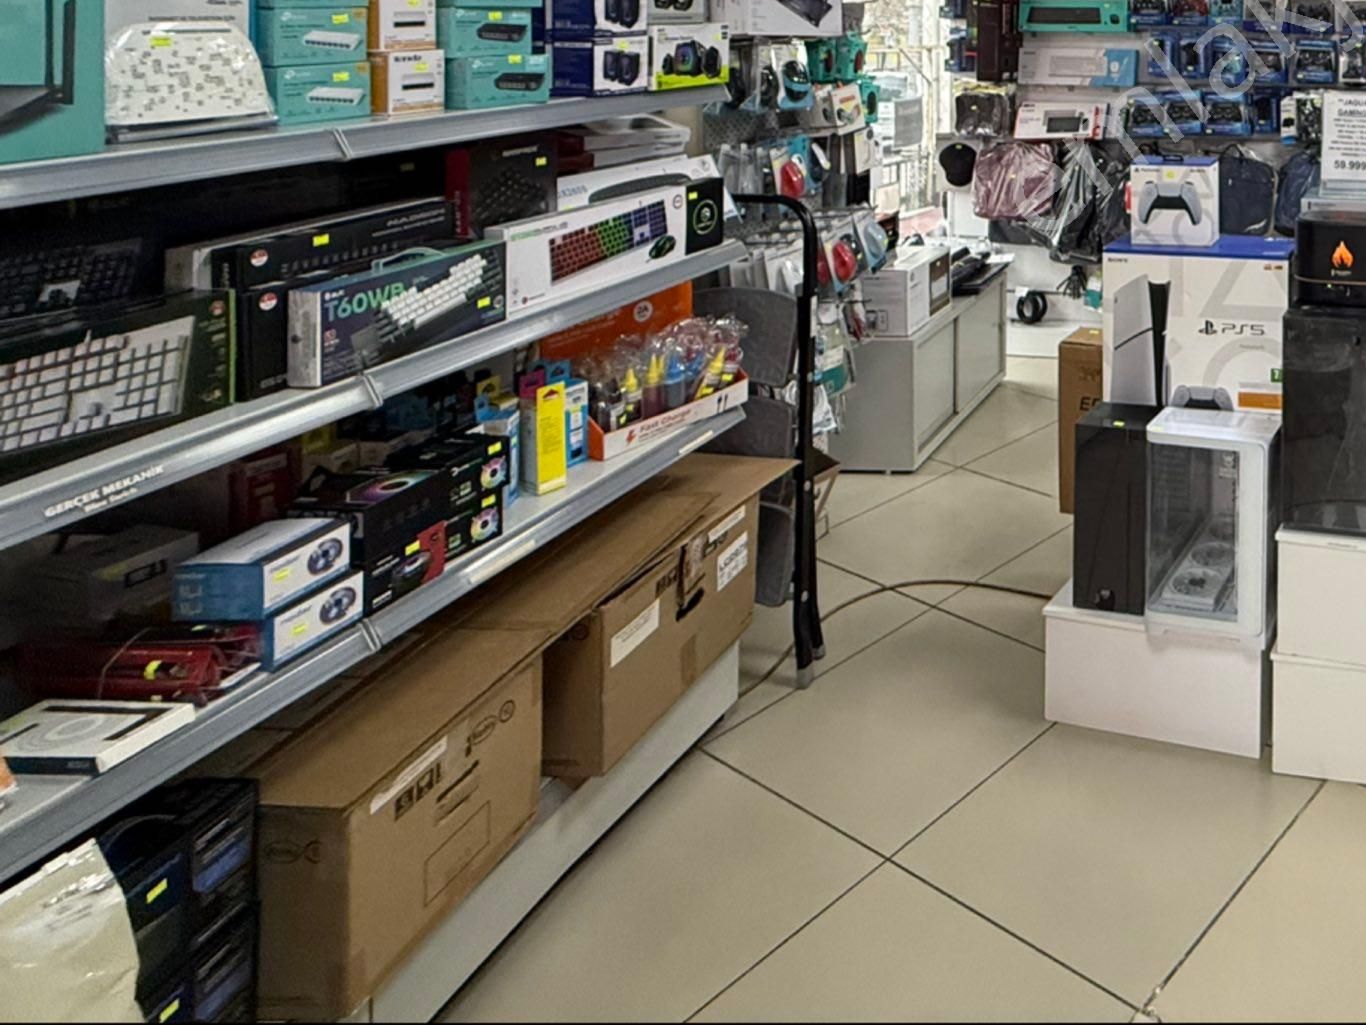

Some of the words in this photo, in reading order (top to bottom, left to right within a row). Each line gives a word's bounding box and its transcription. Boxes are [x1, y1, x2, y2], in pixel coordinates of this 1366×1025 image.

[1220, 323, 1266, 336] PS5
[44, 488, 100, 517] GERÇEK
[101, 464, 164, 496] MEKANİK
